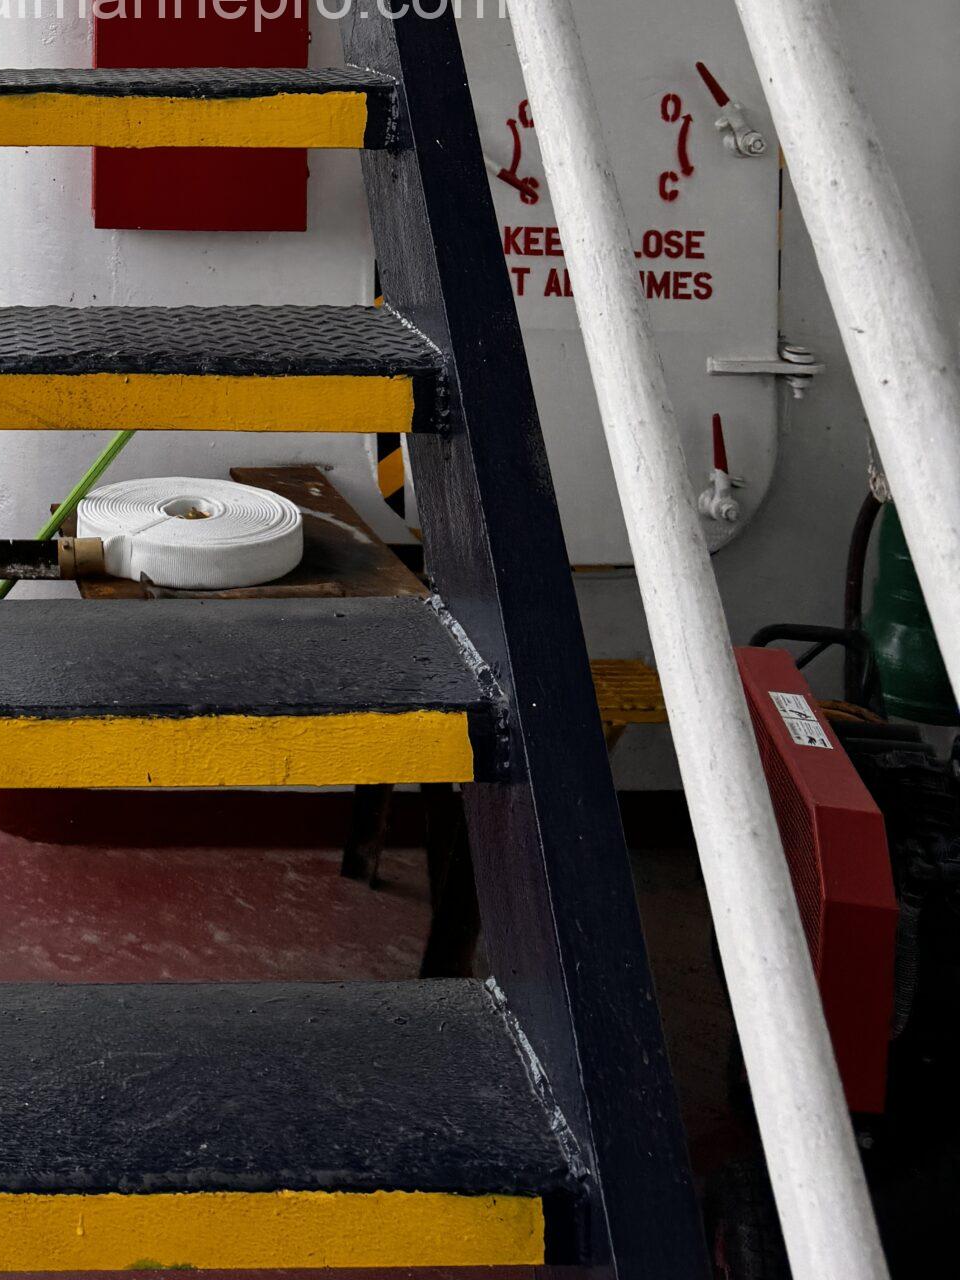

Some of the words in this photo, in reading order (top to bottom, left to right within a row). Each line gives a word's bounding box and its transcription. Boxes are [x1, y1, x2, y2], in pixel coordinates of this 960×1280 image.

[661, 93, 681, 122] O
[658, 171, 679, 202] C
[504, 226, 565, 256] KEE
[634, 230, 705, 259] OSE
[639, 270, 713, 300] MES
